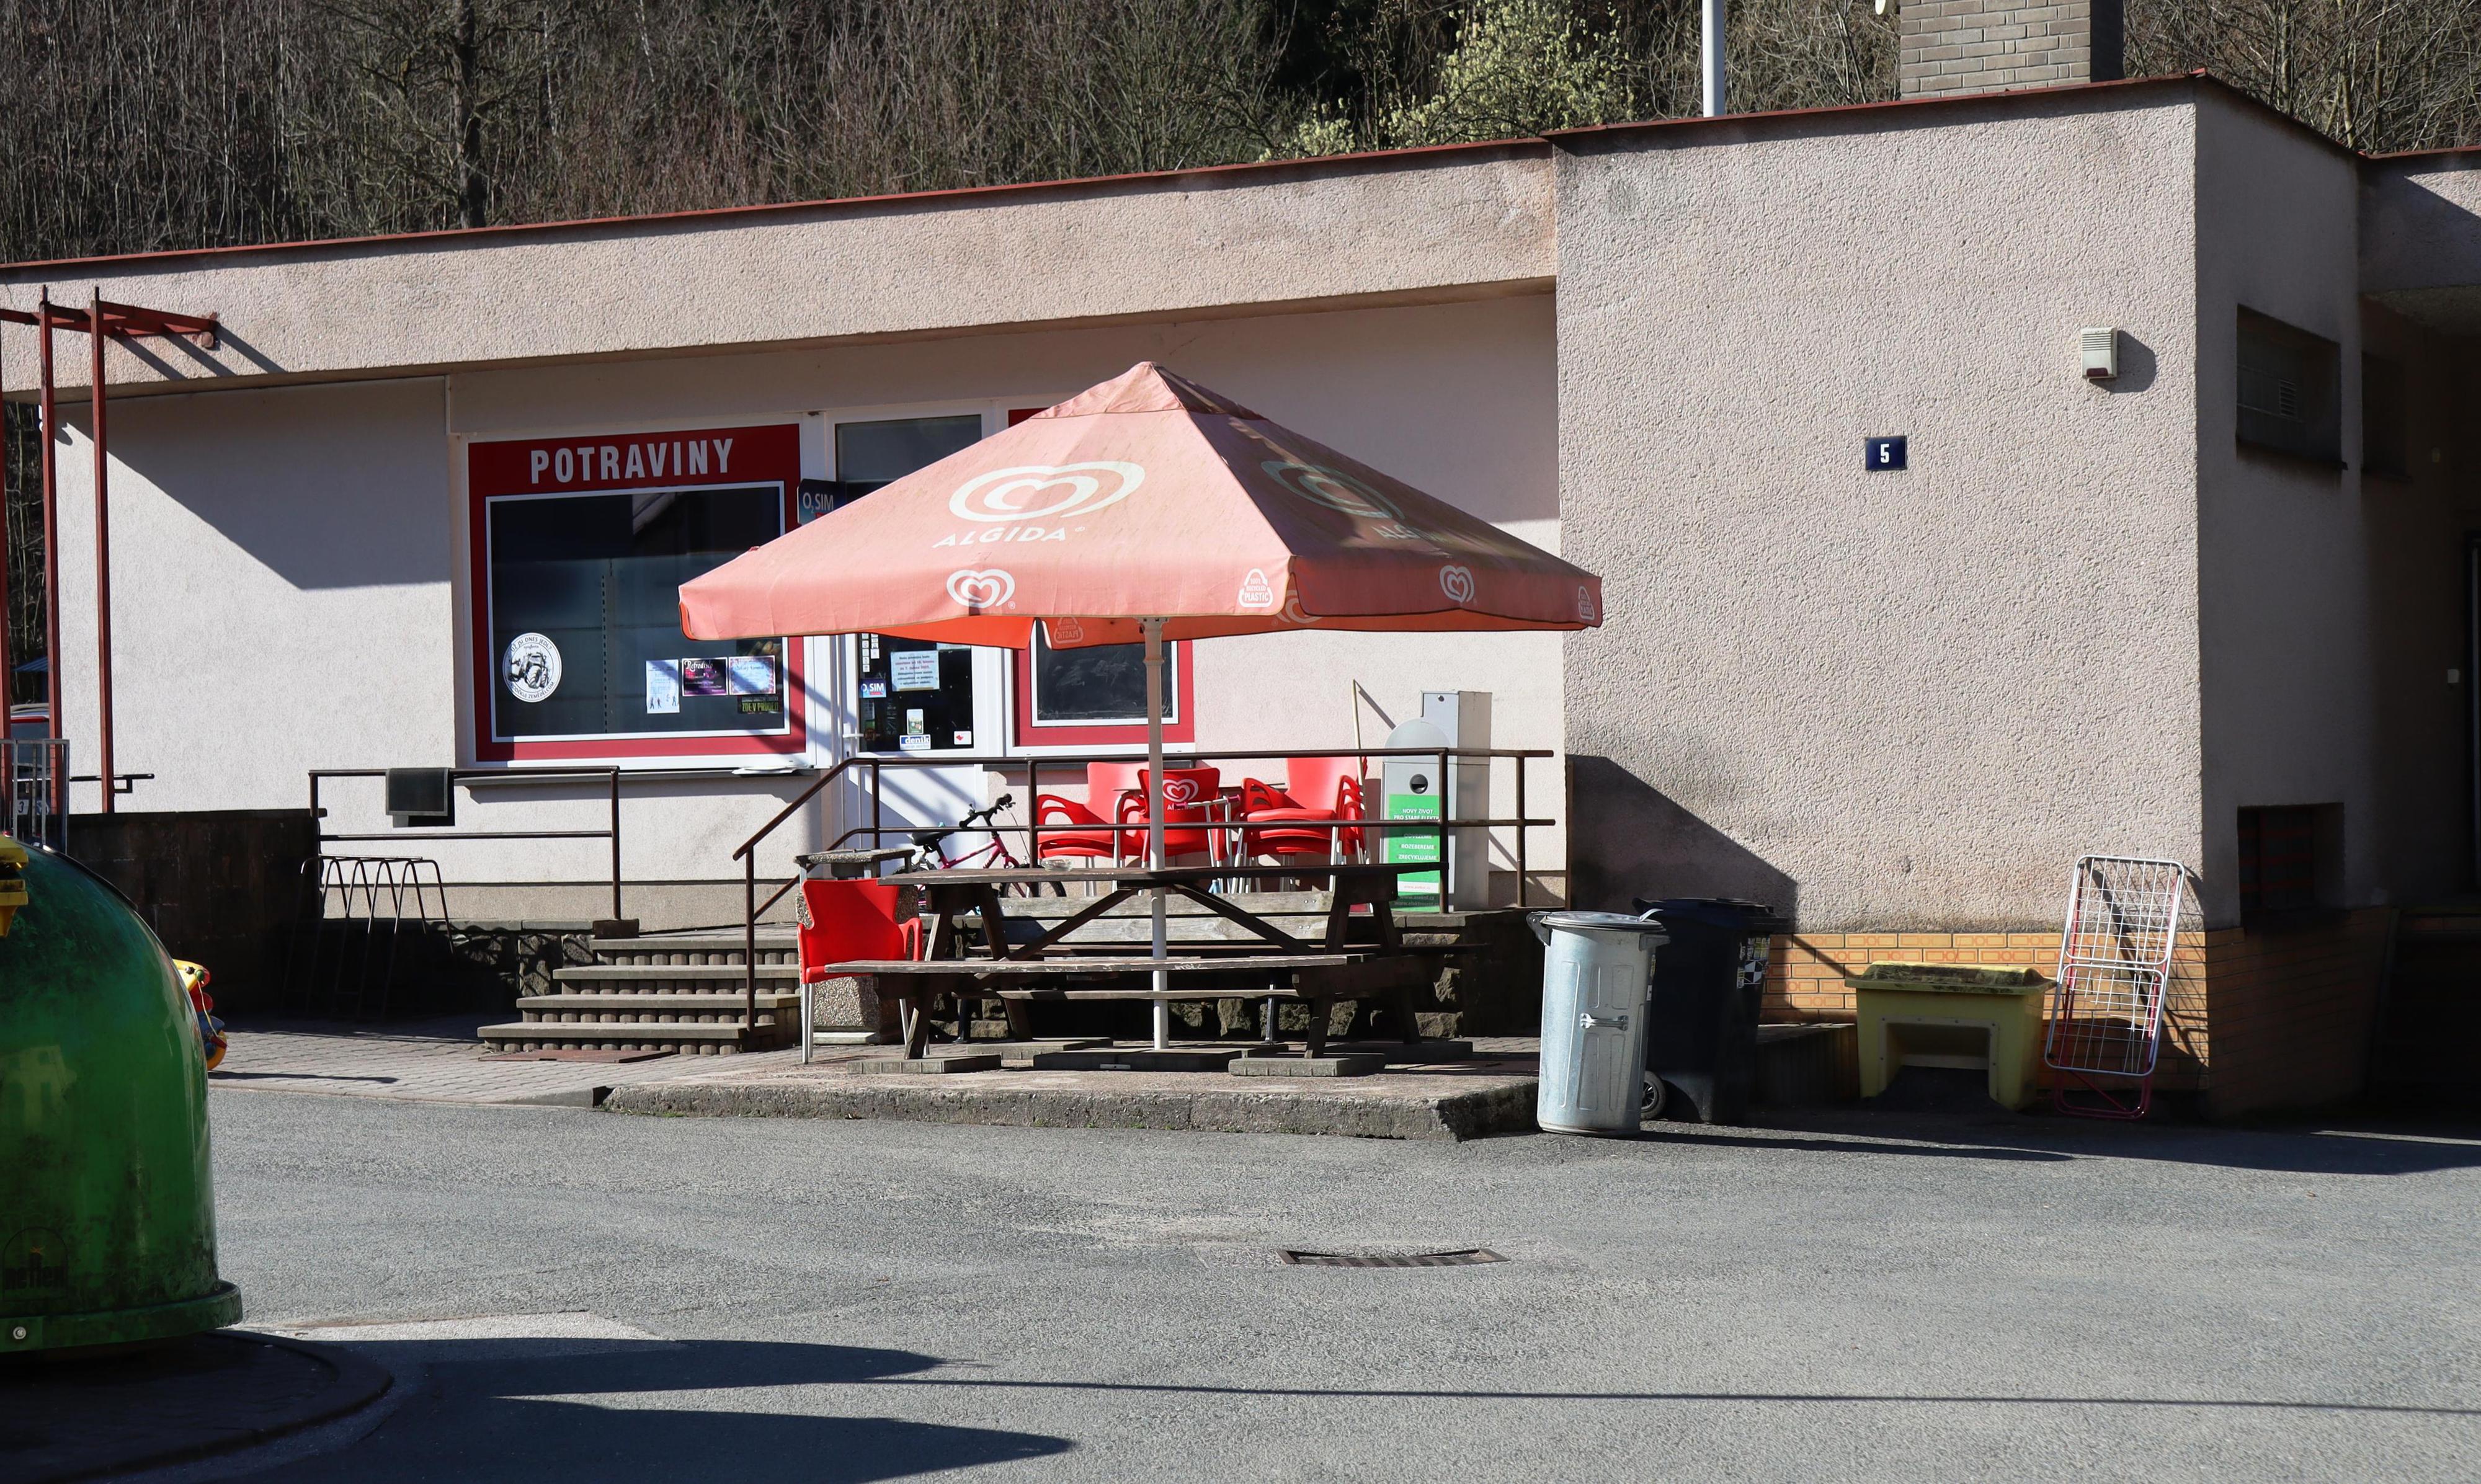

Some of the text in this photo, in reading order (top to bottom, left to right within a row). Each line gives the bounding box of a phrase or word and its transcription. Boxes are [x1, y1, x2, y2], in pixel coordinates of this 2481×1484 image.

[531, 438, 733, 484] POTRAVINY
[1880, 443, 1890, 463] 5
[814, 493, 834, 510] SIM
[931, 526, 1066, 548] ALGIDA
[1244, 592, 1269, 602] PLASTIC
[870, 683, 884, 692] SIM
